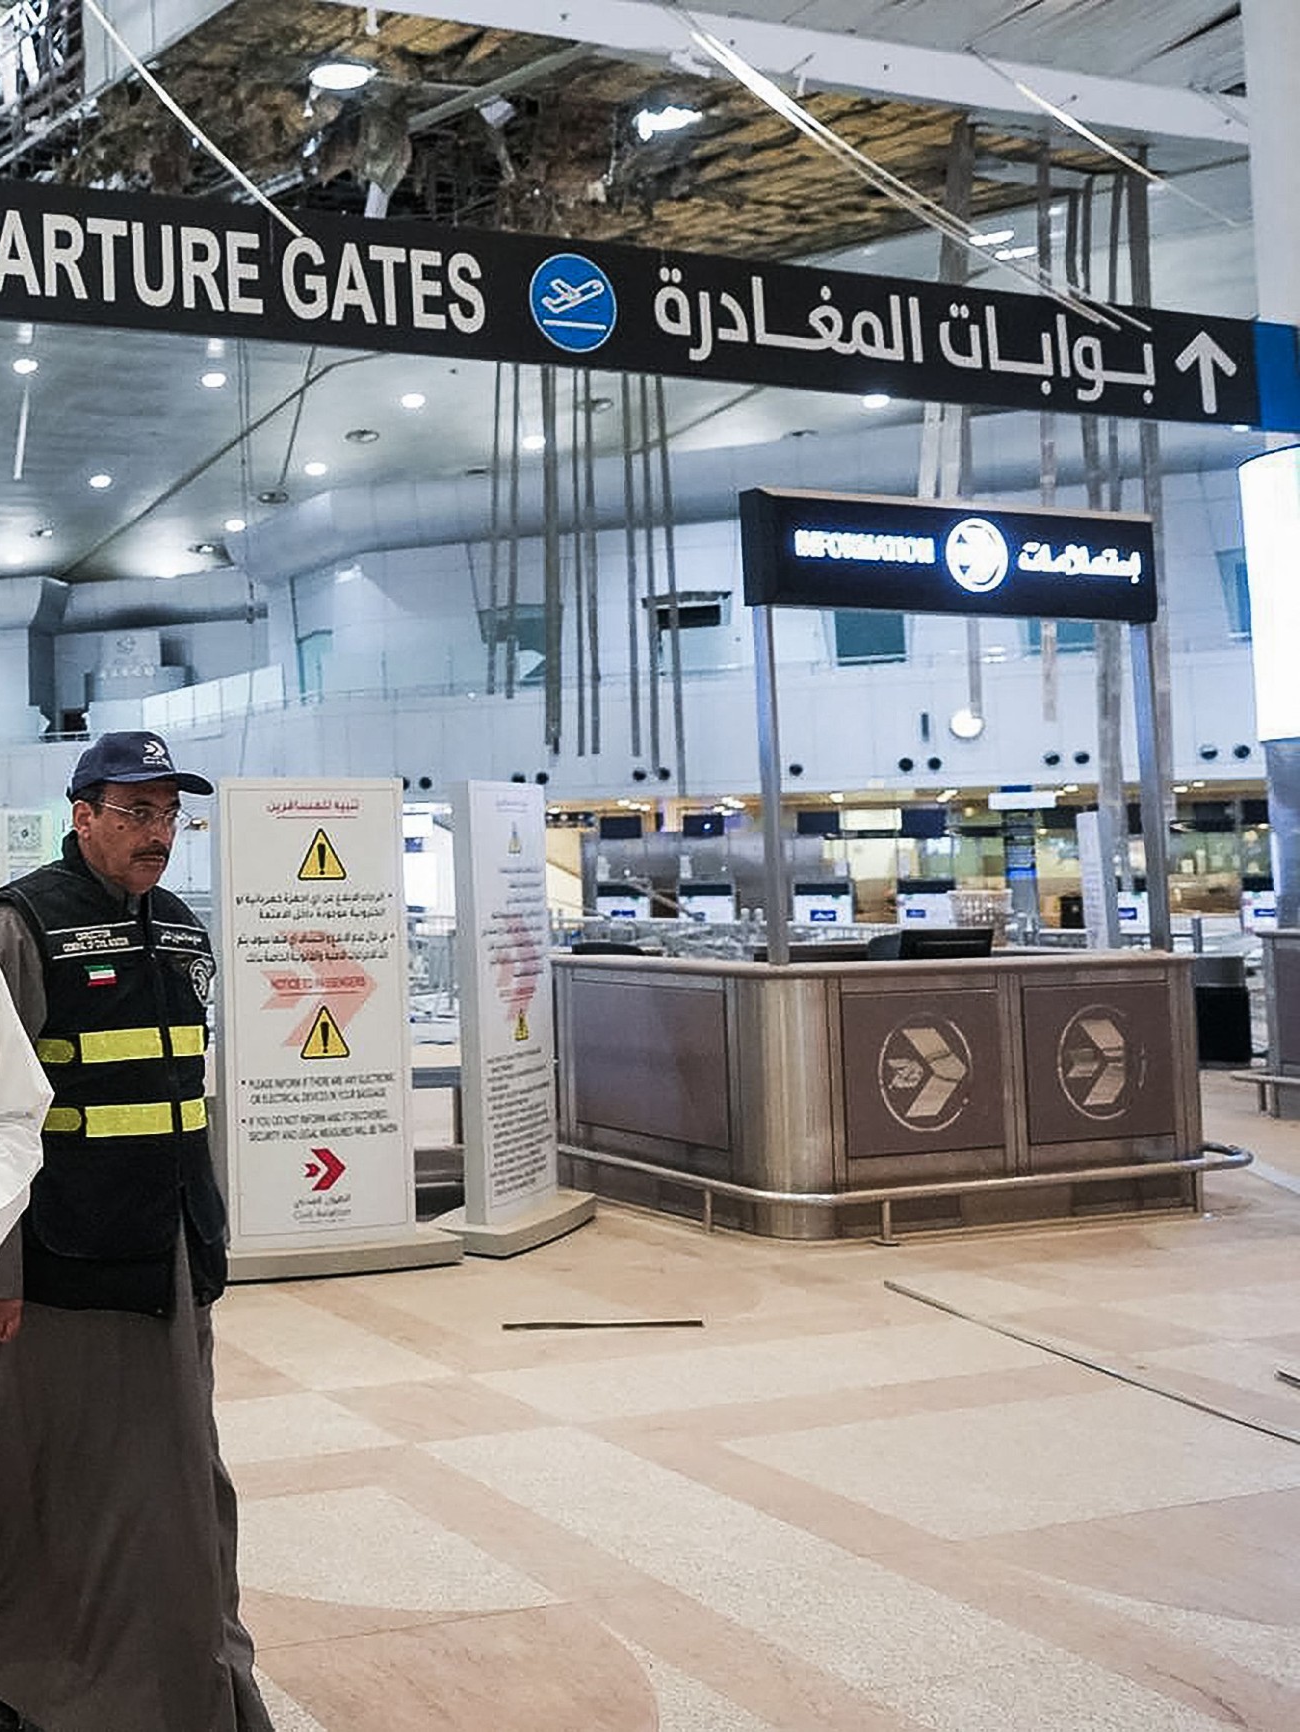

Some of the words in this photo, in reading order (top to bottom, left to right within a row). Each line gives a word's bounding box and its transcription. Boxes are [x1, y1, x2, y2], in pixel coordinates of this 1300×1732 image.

[281, 235, 486, 335] GATES
[654, 266, 924, 363] المغادرة
[939, 301, 1156, 405] بوابات
[794, 529, 936, 564] INFORMATION
